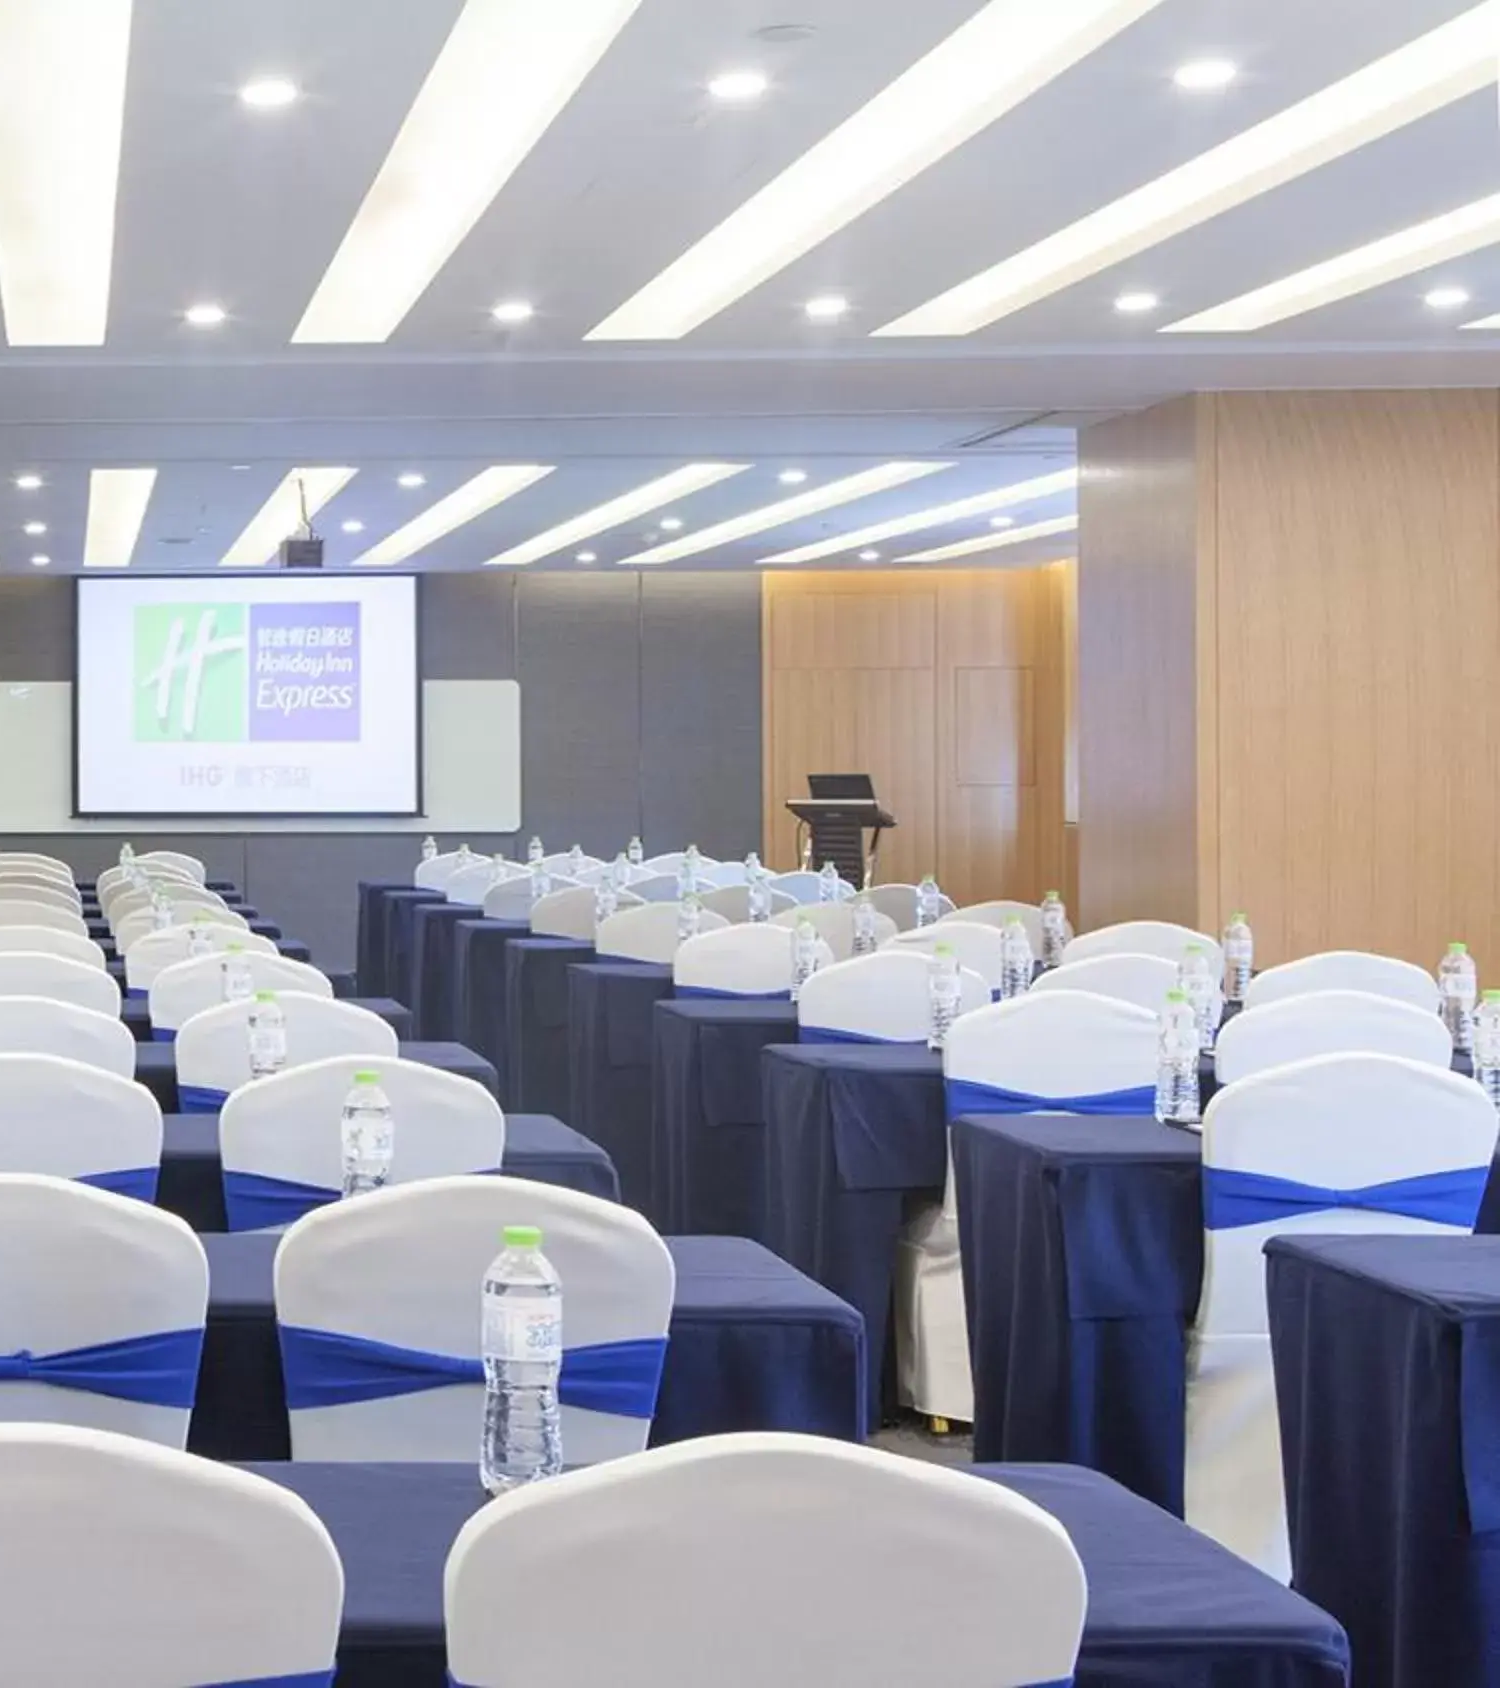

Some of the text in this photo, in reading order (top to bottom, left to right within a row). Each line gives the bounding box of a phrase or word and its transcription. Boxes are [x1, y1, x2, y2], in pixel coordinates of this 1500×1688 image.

[256, 651, 354, 678] Holiday Inn
[256, 678, 353, 717] Express
[180, 765, 223, 788] IHG
